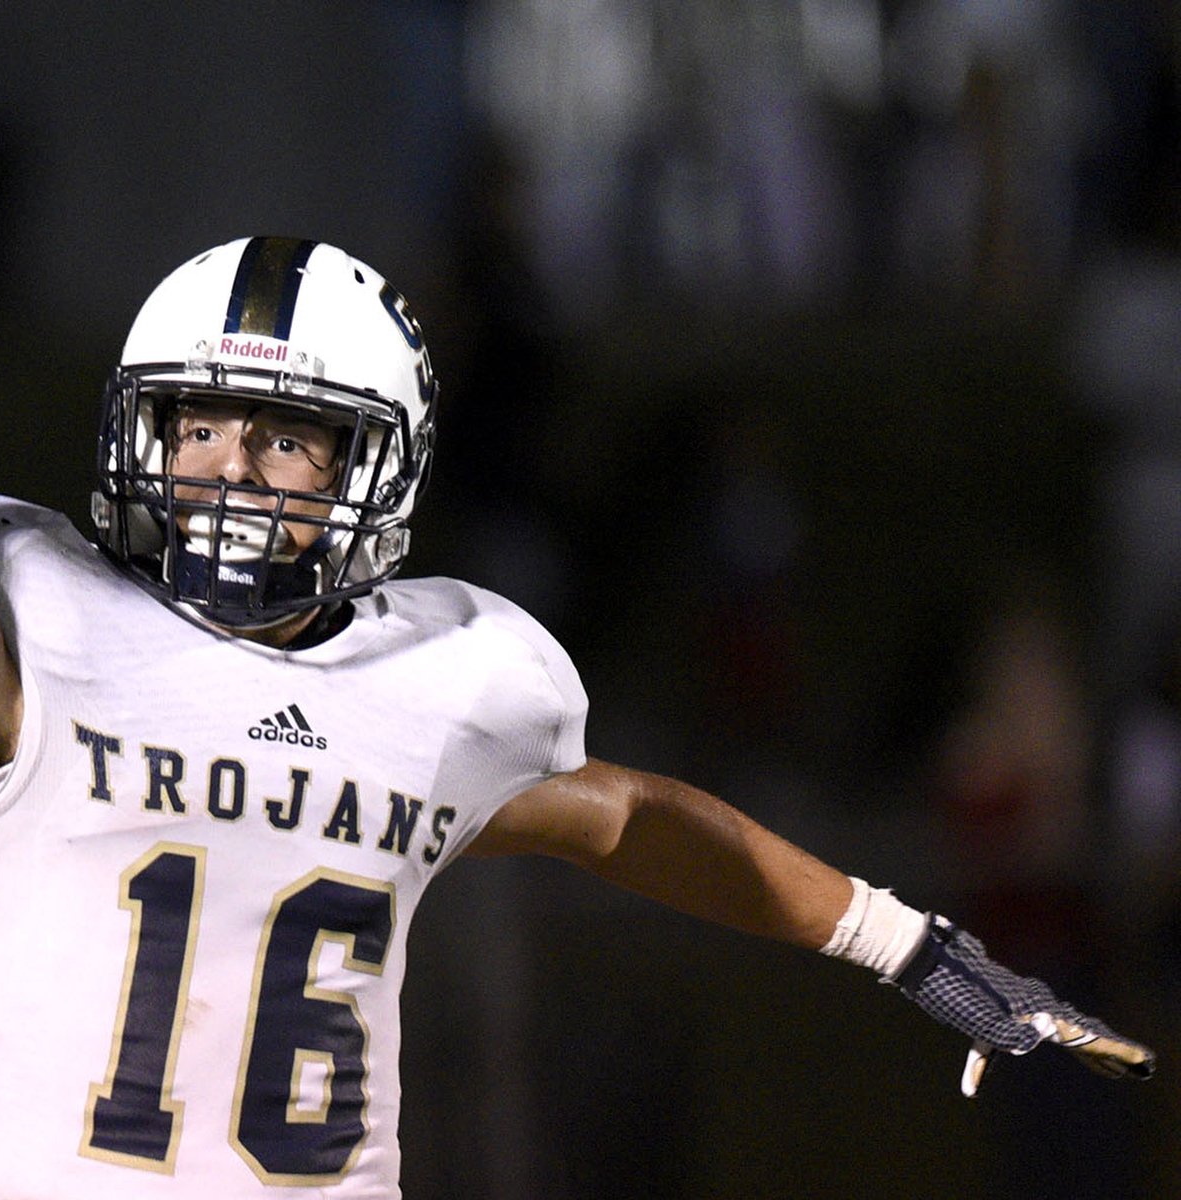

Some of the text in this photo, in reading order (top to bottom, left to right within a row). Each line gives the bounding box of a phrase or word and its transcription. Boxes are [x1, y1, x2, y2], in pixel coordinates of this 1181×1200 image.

[220, 338, 288, 362] Riddell
[247, 726, 328, 751] adidas
[71, 718, 458, 866] TROJANS
[78, 840, 397, 1188] 16
